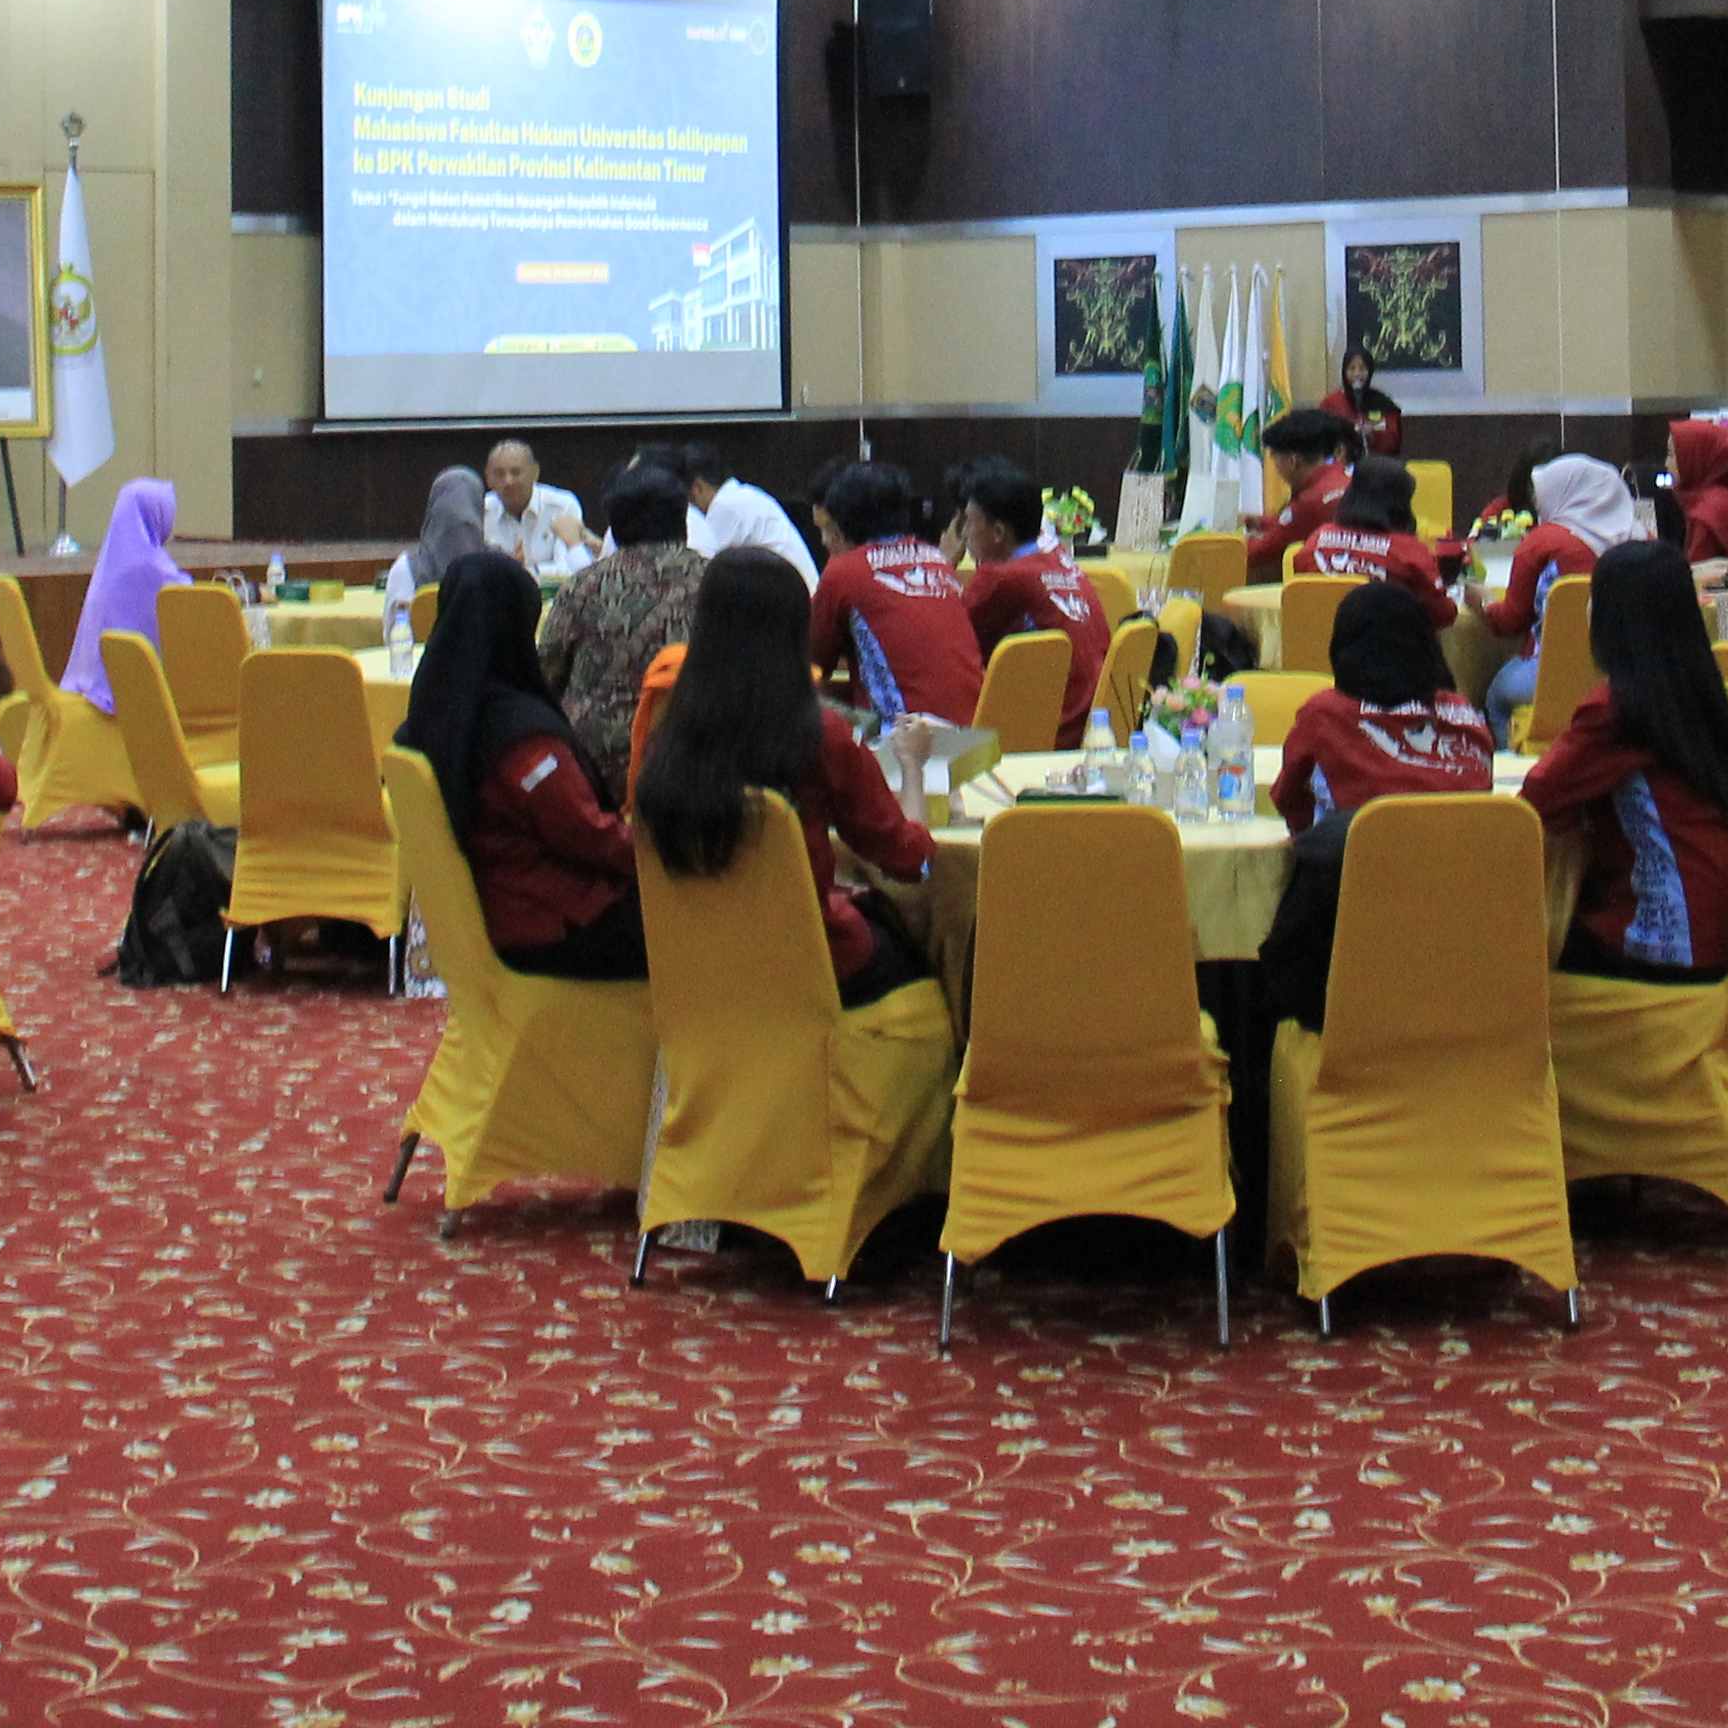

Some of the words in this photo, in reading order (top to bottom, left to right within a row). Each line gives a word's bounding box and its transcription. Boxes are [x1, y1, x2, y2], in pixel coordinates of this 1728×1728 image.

[353, 82, 444, 113] Kunjungan
[446, 85, 490, 111] Studi
[353, 115, 448, 142] Mahasiswa
[449, 118, 519, 145] Fakultas
[521, 120, 577, 148] Hukum
[580, 122, 664, 150] Universitas
[666, 126, 748, 156] Balikpapan
[353, 148, 374, 174] ke
[376, 149, 414, 174] BPK
[417, 149, 507, 177] Perwakilan
[508, 152, 570, 179] Provinsi
[573, 154, 661, 181] Kalimantan
[663, 157, 706, 183] Timur
